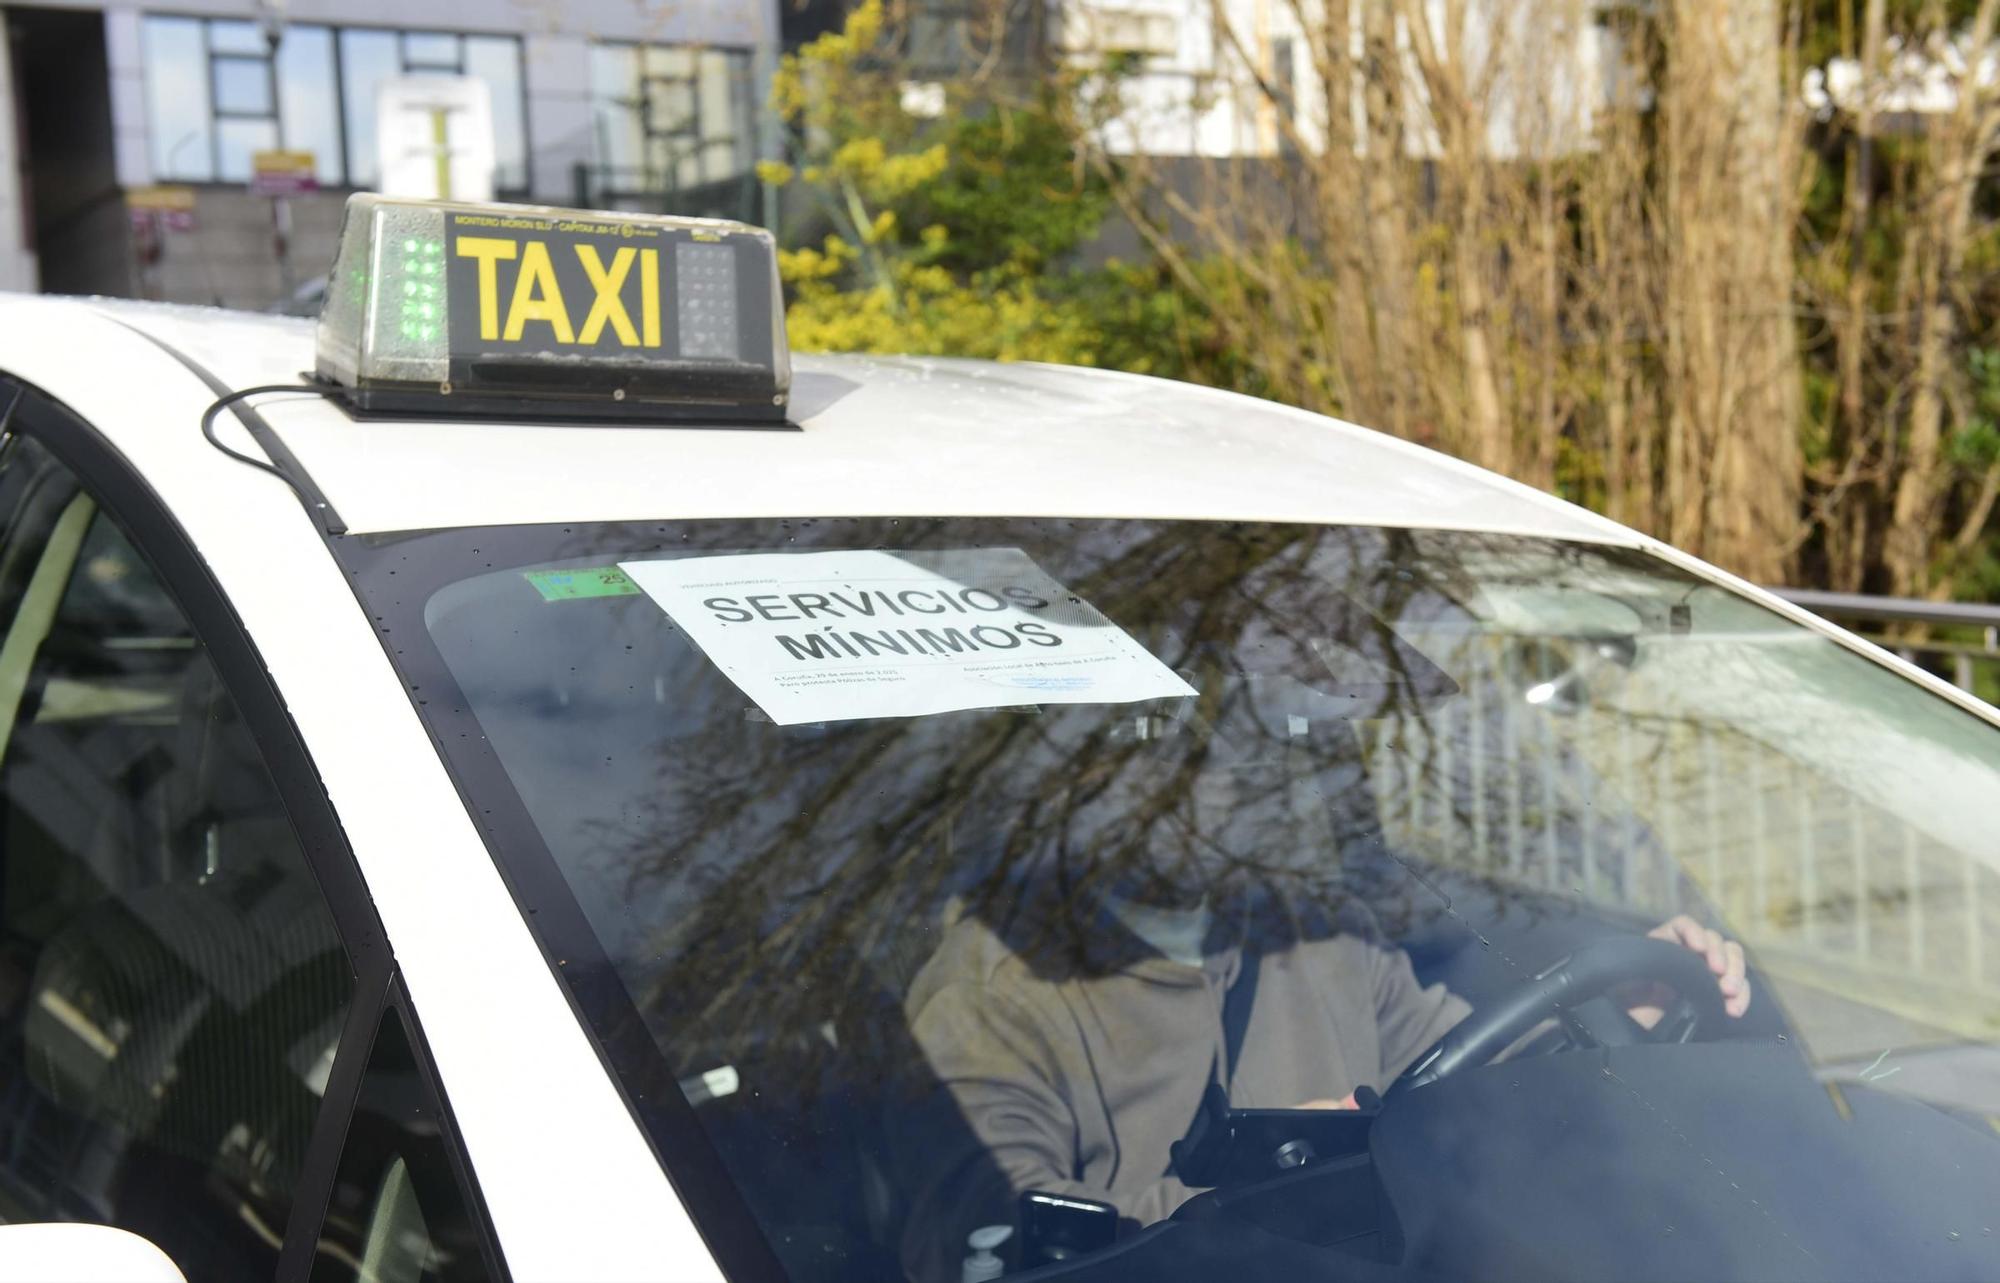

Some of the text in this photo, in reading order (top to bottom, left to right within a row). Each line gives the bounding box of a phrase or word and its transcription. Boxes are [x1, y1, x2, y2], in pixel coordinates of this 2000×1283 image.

[454, 215, 499, 227] MONTERO
[456, 235, 661, 348] TAXI
[599, 573, 626, 585] 25
[703, 586, 1049, 622] SERVICIOS
[775, 623, 1063, 661] MÍNIMOS
